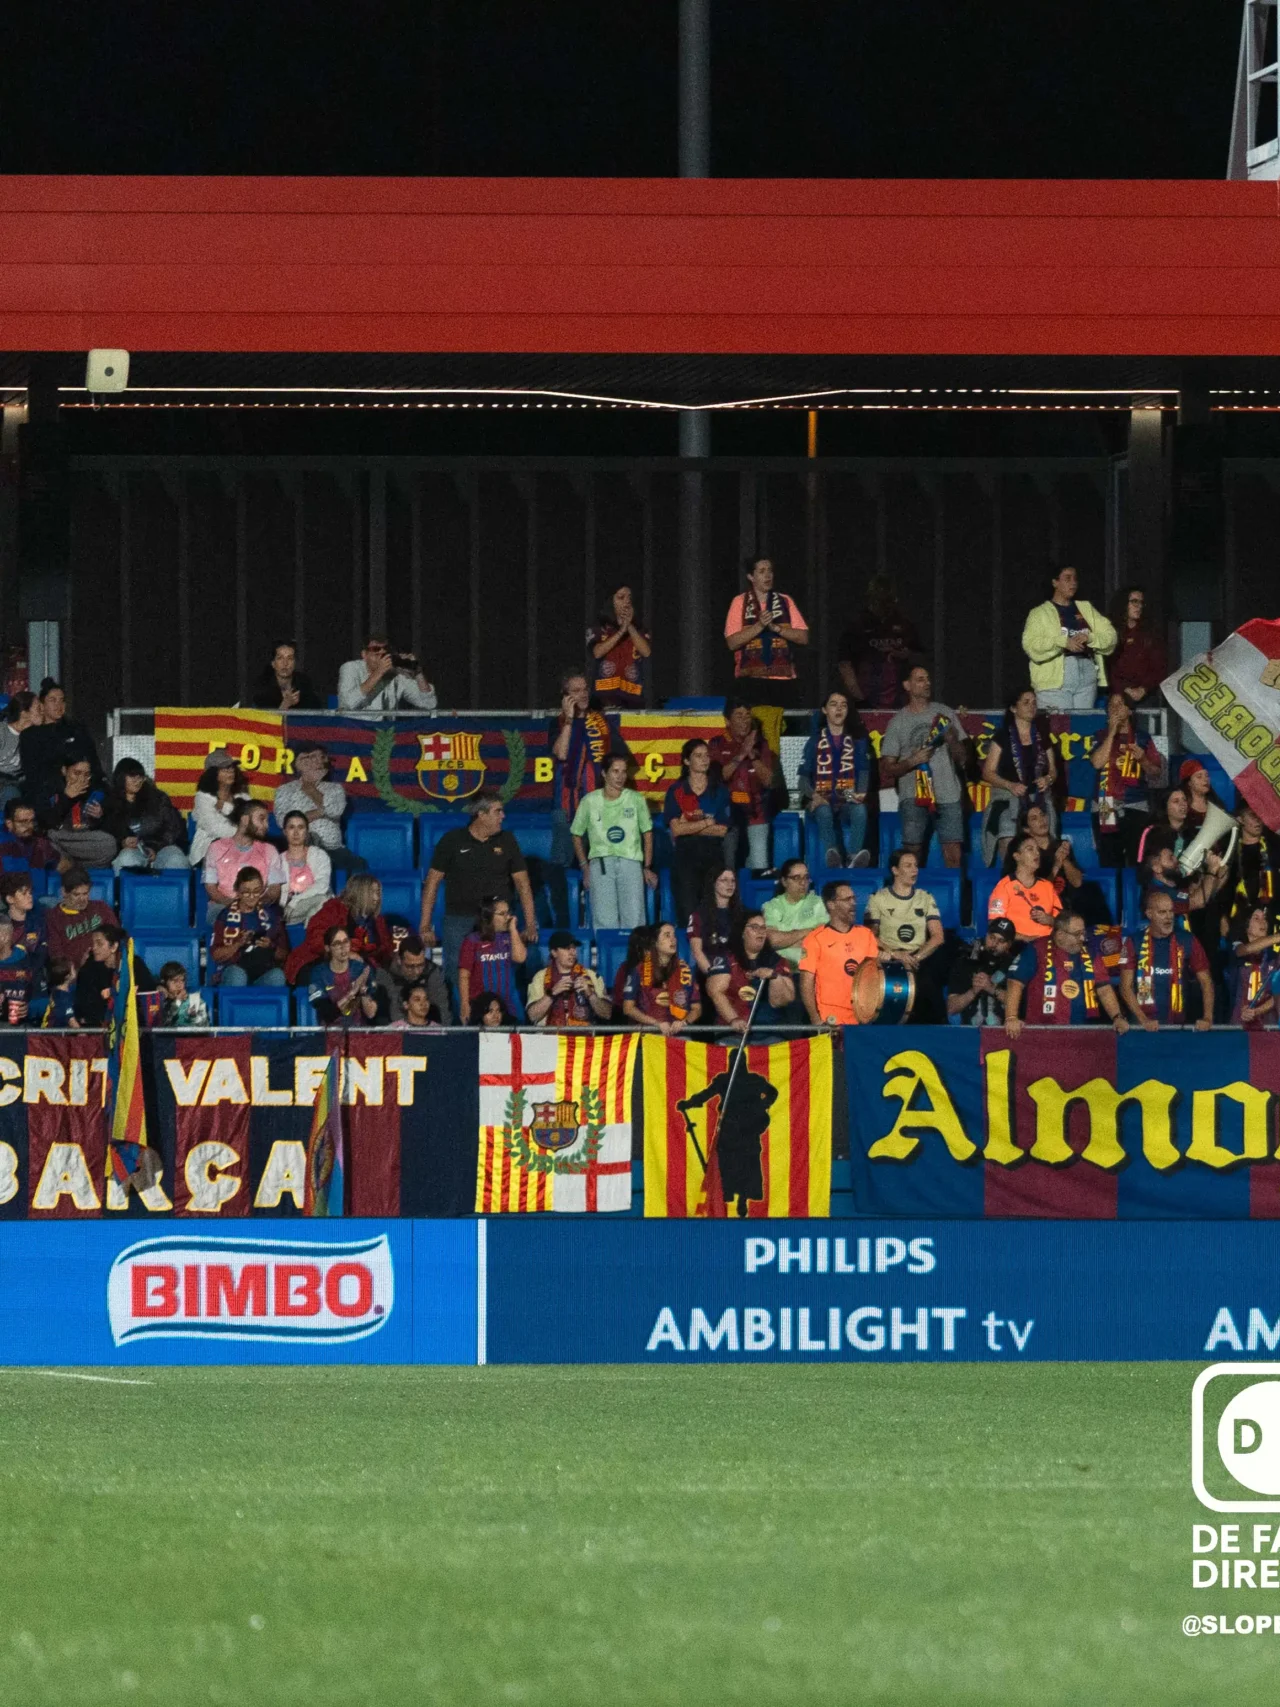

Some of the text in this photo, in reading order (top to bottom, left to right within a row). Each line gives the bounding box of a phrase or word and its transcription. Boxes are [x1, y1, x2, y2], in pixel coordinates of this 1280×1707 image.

[437, 760, 465, 769] FCB
[817, 754, 832, 774] FC
[163, 1055, 428, 1107] VALENT
[745, 1237, 936, 1273] PHILIPS
[130, 1263, 373, 1318] BIMBO
[645, 1306, 1035, 1352] AMBILIGHT tv
